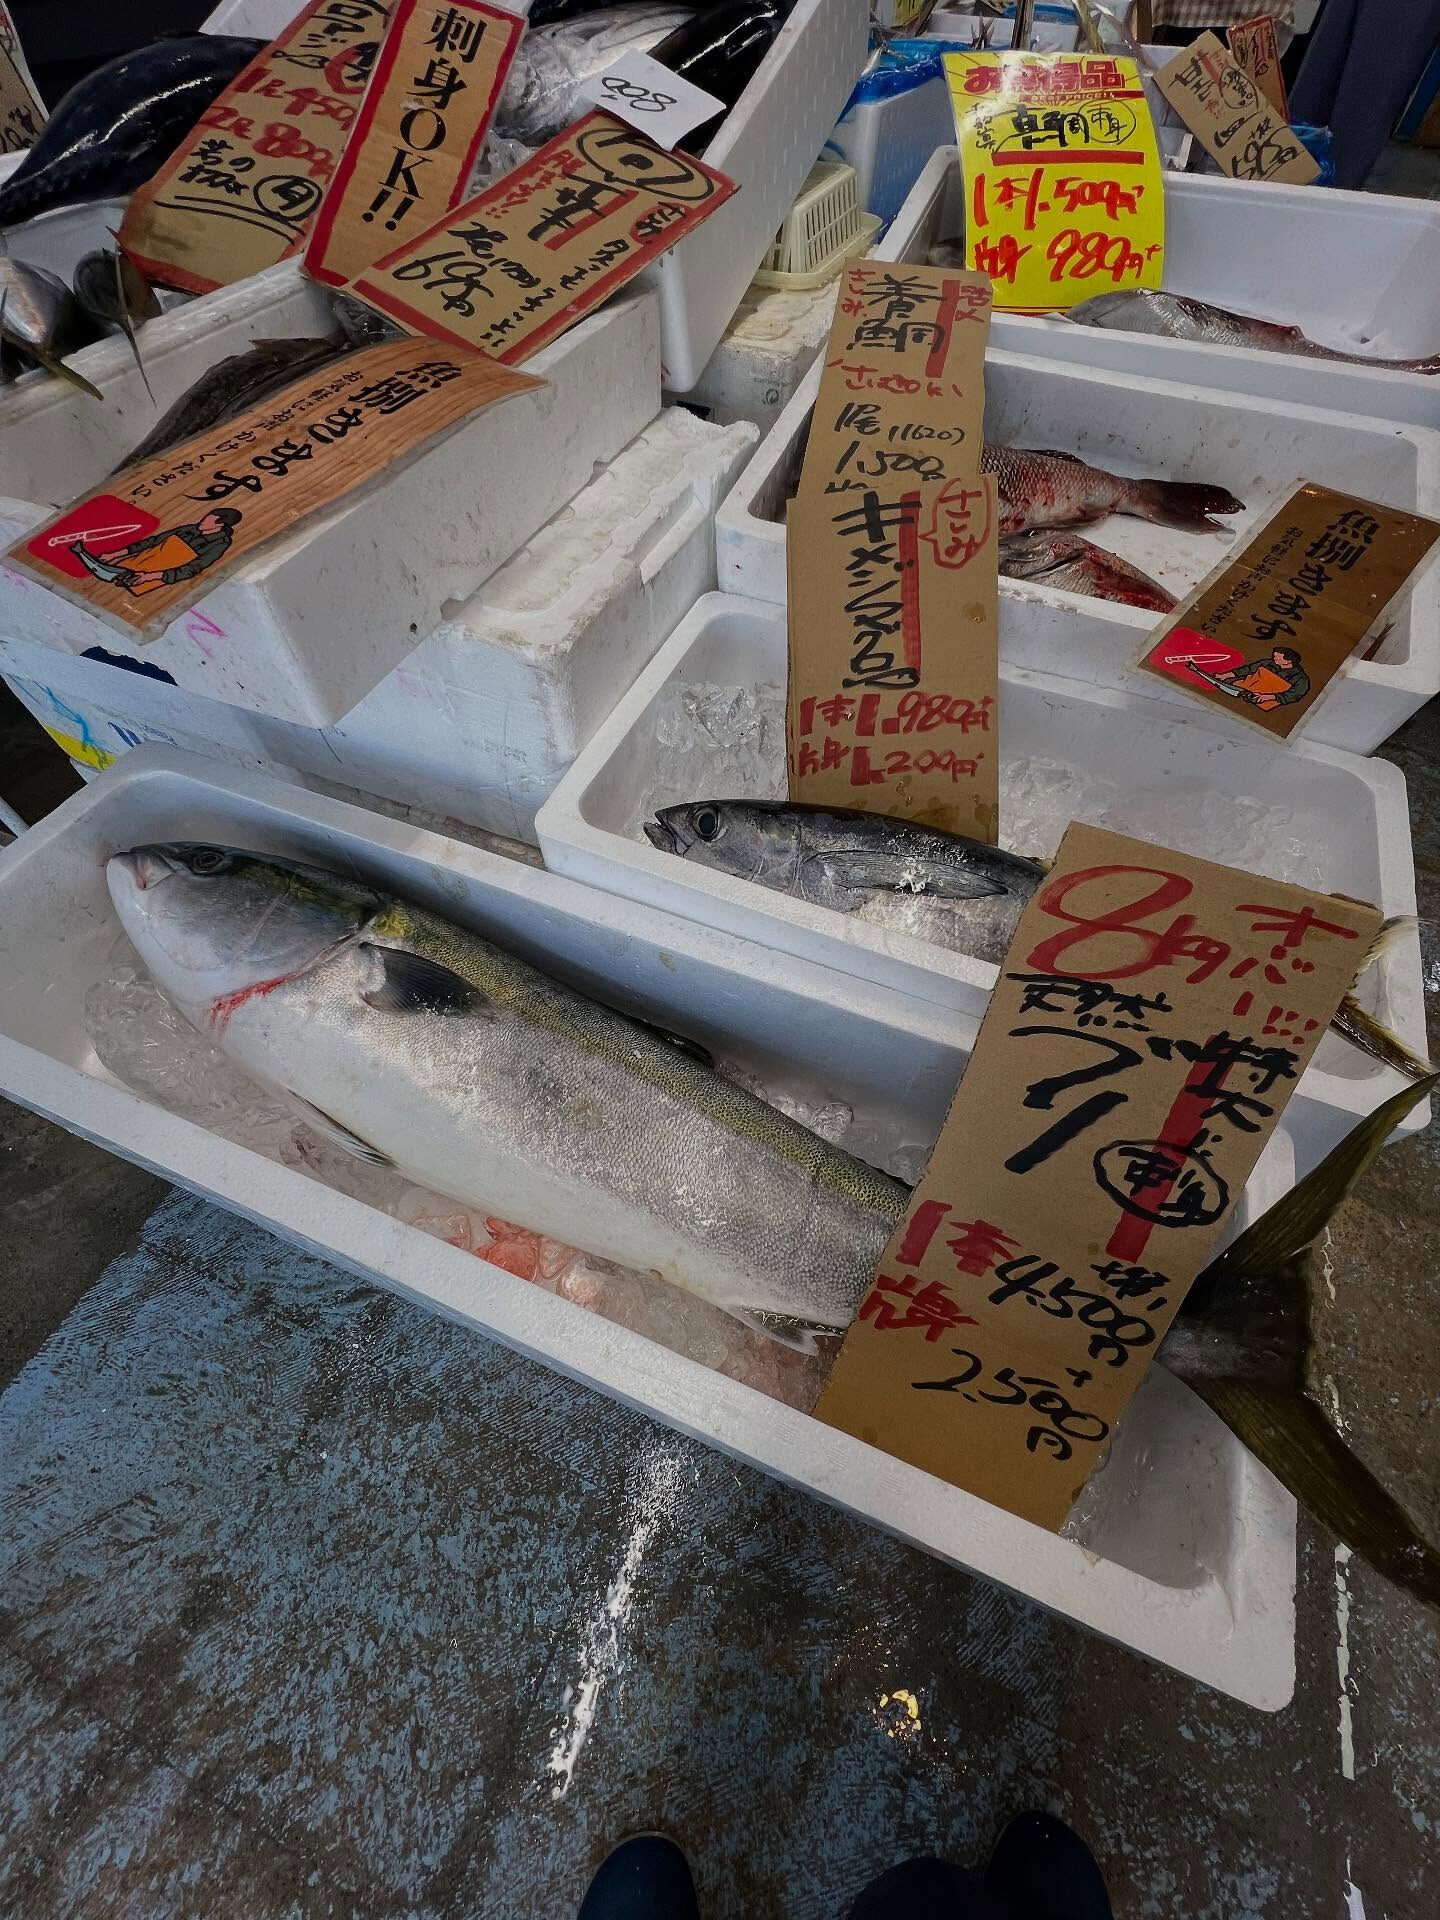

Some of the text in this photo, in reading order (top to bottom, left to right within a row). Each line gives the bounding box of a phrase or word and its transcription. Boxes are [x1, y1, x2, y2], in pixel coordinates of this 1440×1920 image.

[361, 8, 488, 231] 刺身OK!!
[185, 361, 462, 502] 魚捌きます
[1244, 509, 1381, 640] 魚捌きます
[1027, 865, 1231, 984] 8kg
